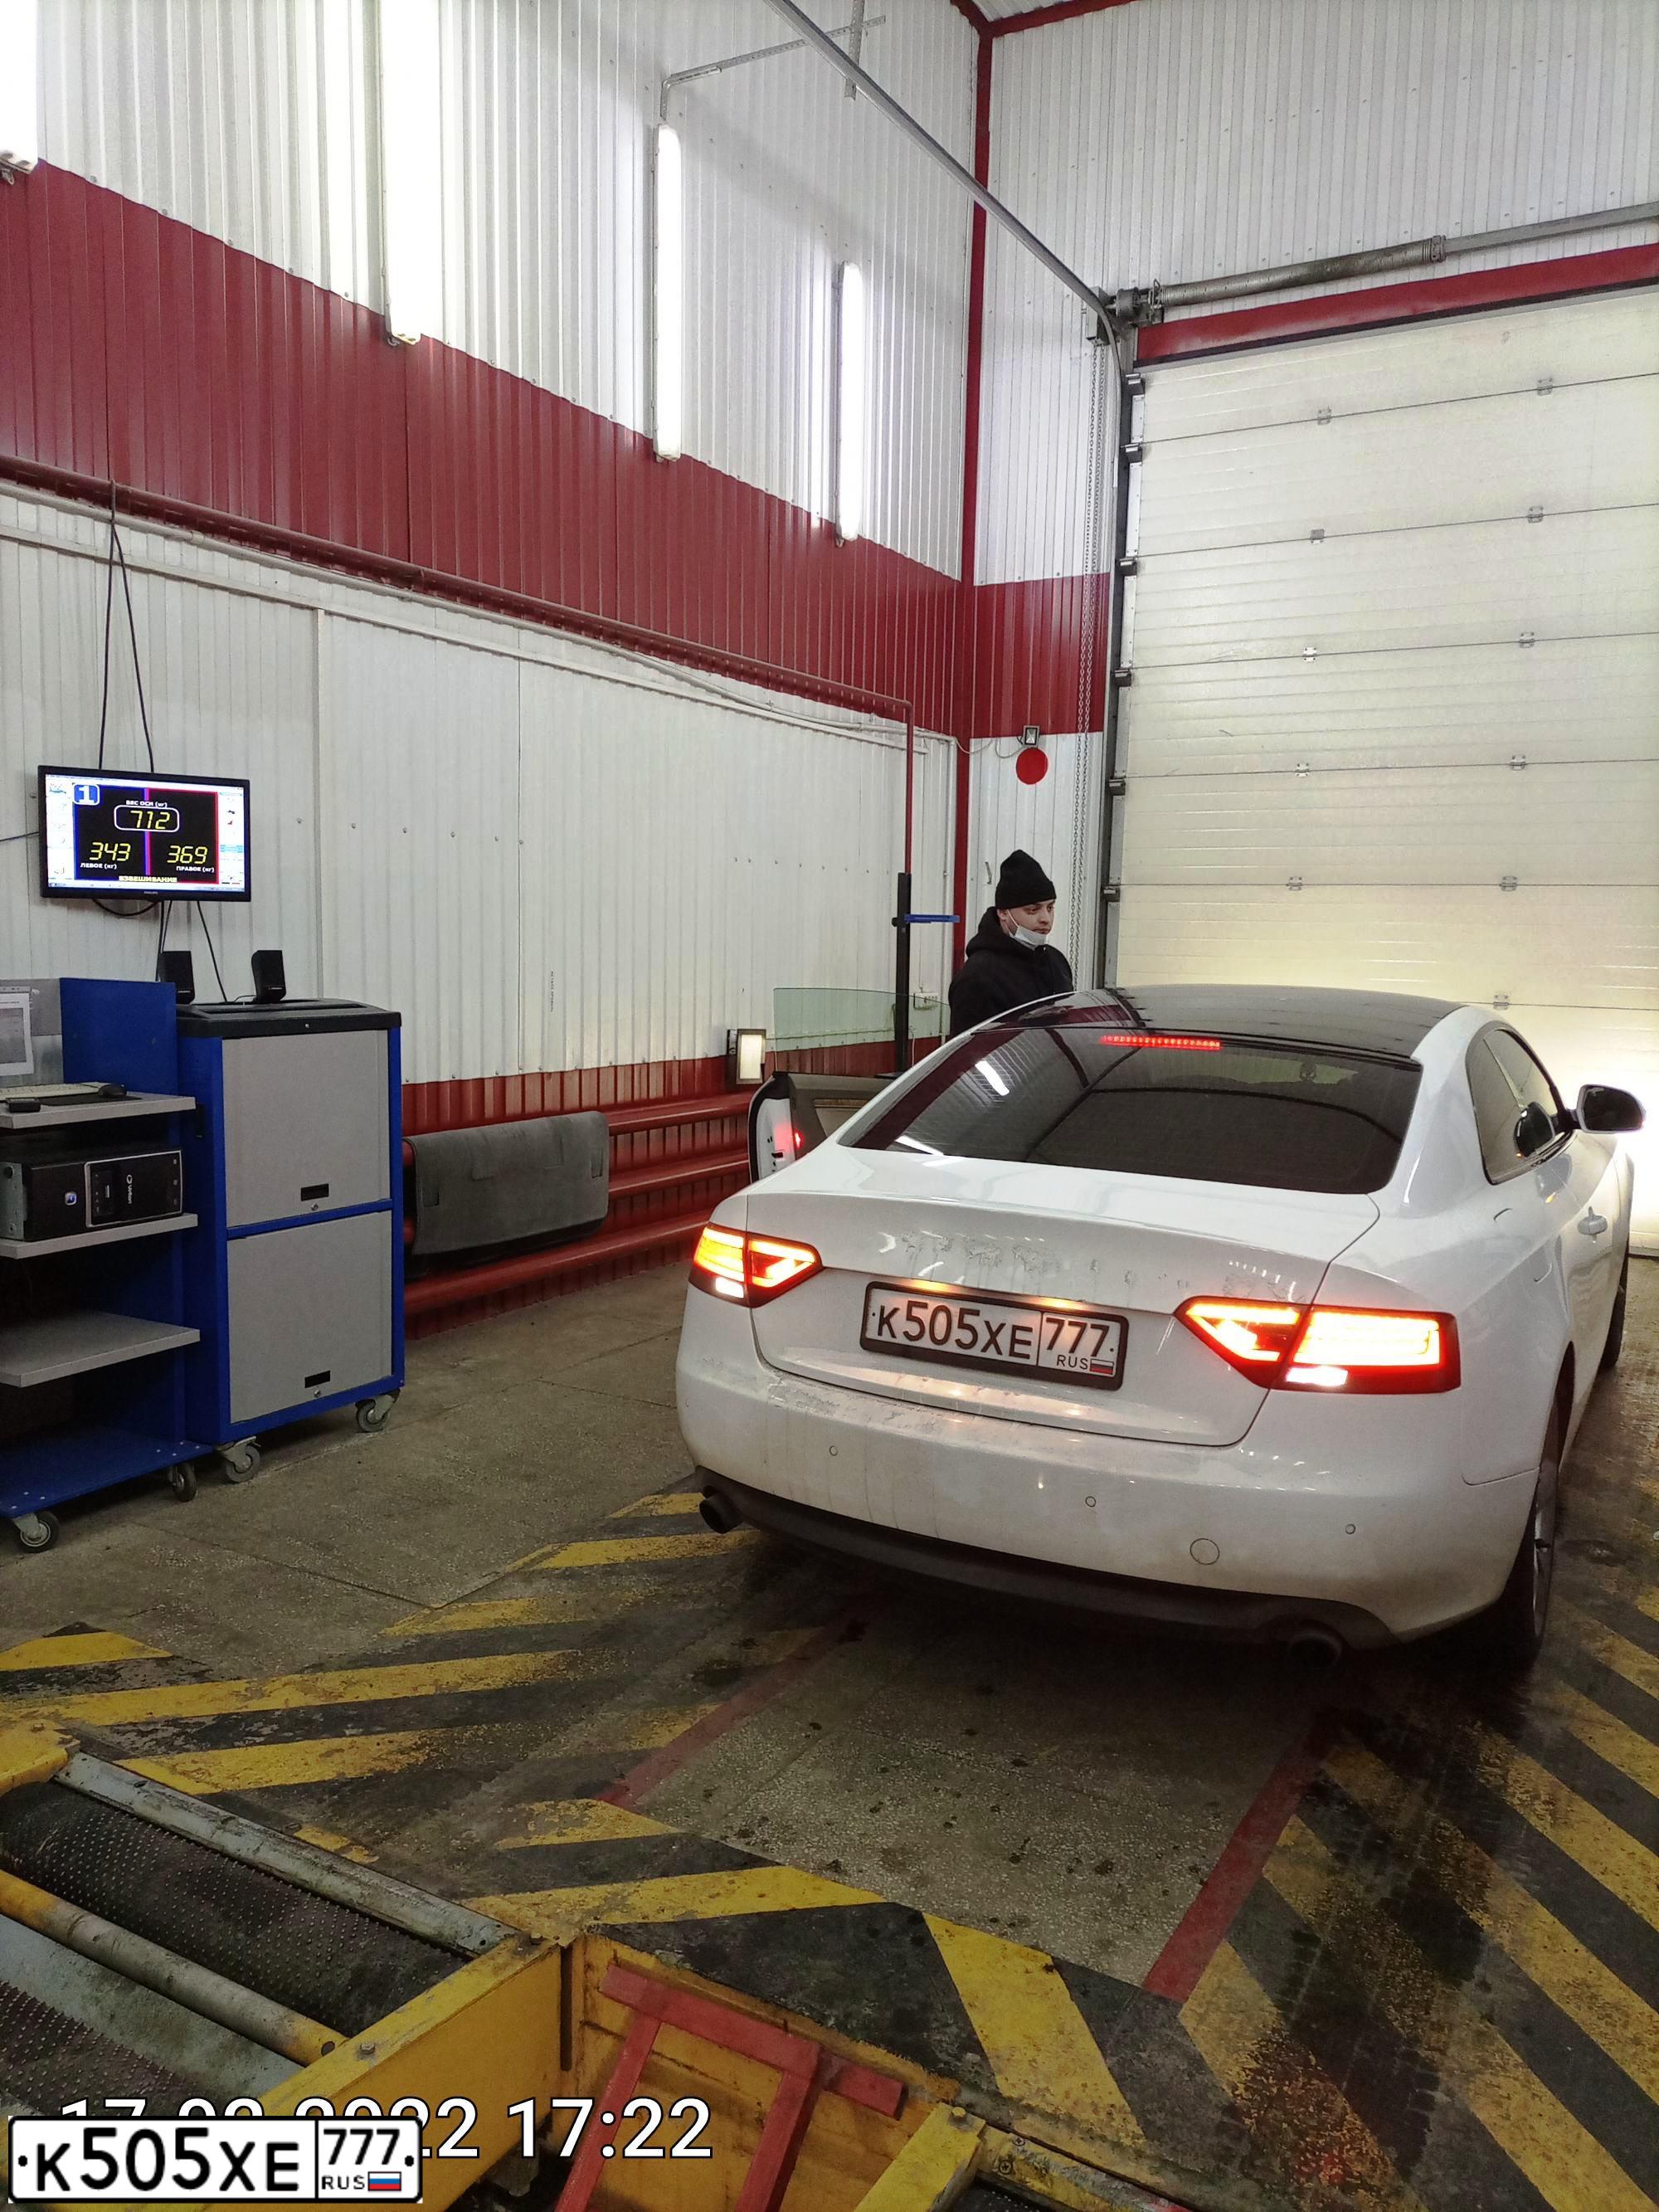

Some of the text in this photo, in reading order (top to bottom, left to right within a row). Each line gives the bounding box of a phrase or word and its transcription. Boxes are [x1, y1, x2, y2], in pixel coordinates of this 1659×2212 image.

[78, 785, 95, 803] 1
[130, 810, 171, 830] 712
[89, 841, 131, 862] 343
[167, 845, 208, 865] 369
[1045, 1317, 1111, 1357] 777
[1056, 1355, 1088, 1370] RUS
